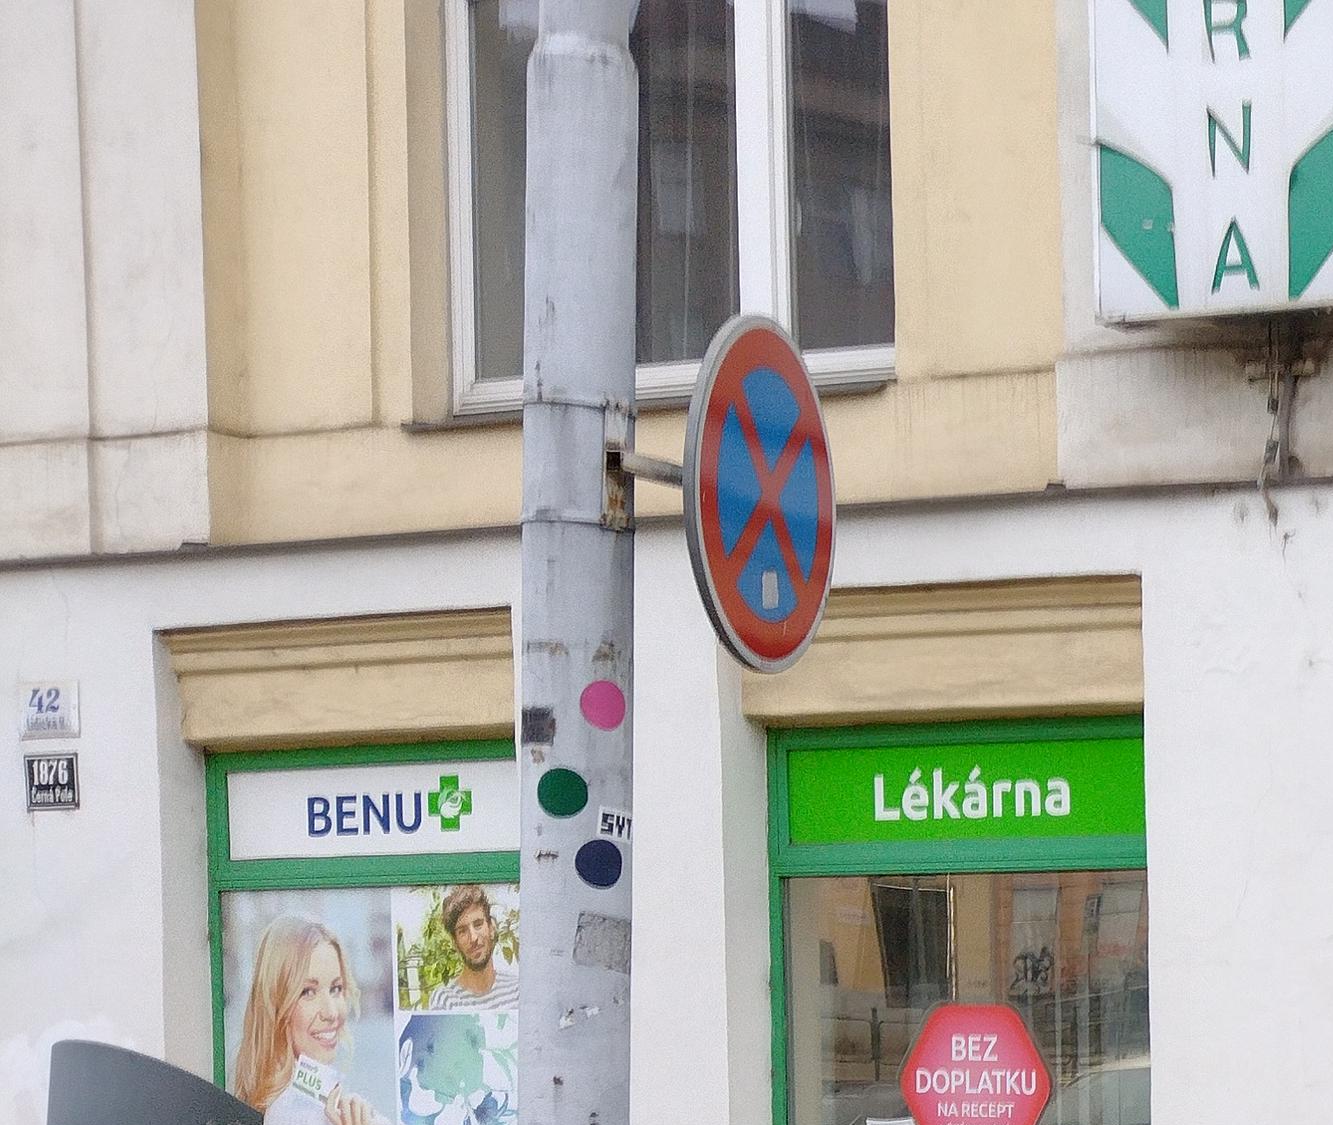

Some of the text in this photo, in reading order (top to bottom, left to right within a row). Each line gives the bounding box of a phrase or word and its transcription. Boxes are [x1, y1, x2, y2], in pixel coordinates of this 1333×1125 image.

[29, 688, 60, 714] 42
[32, 759, 69, 786] 1876
[873, 765, 1071, 822] Lékárna
[307, 793, 423, 836] BENU
[951, 1034, 998, 1062] BEZ
[296, 1070, 322, 1091] PLUS
[915, 1068, 1037, 1096] DOPLATKU
[937, 1103, 1014, 1119] NA RECEPT
